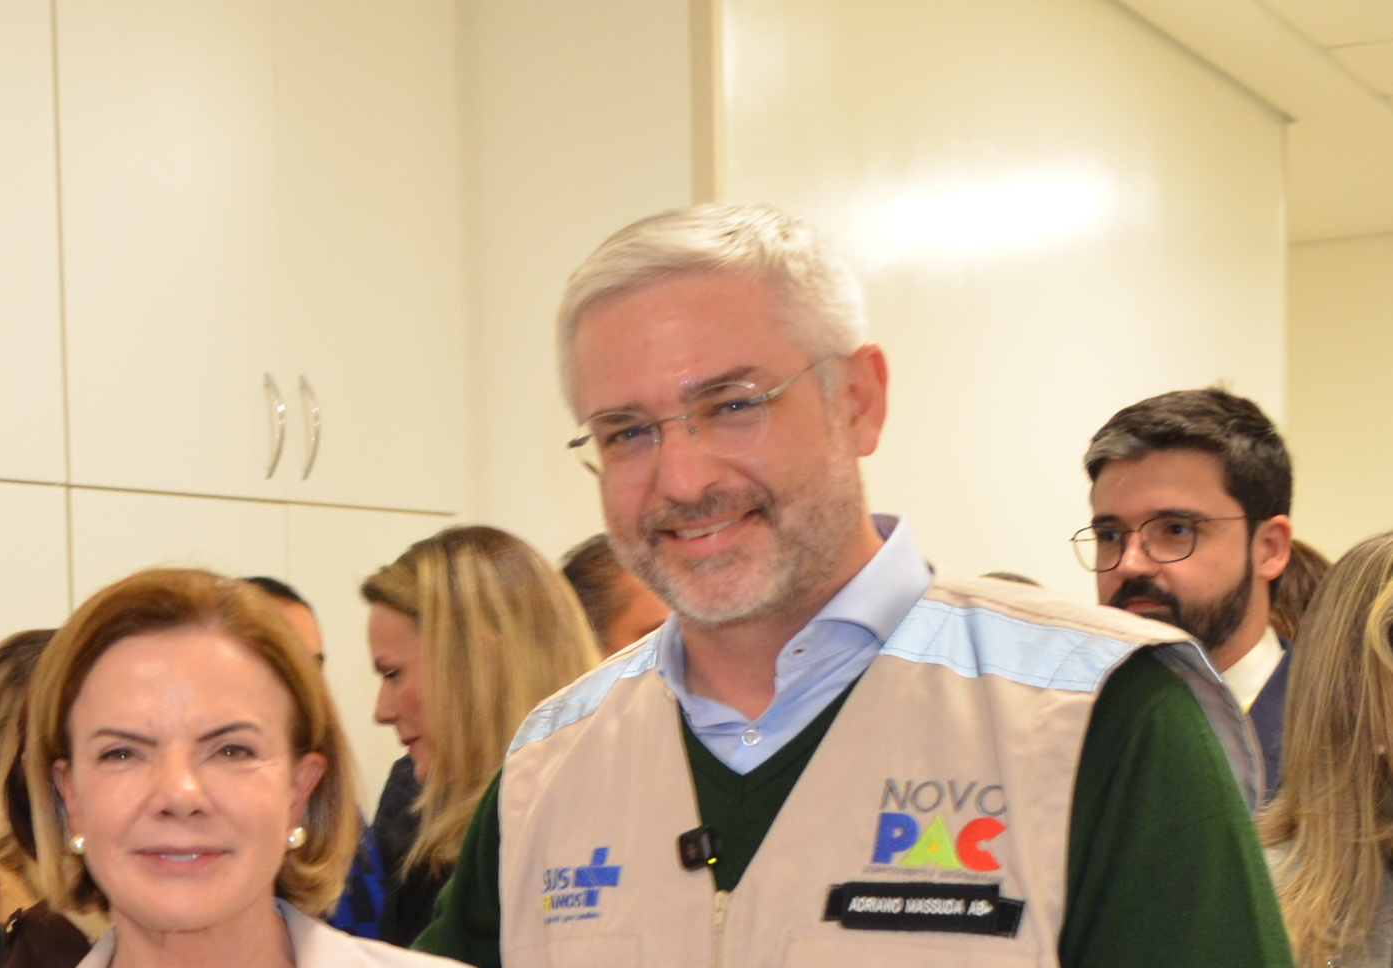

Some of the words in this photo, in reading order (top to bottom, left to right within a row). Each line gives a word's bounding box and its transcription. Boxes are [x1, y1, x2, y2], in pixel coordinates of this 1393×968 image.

[879, 778, 1007, 816] NOVO
[871, 811, 1007, 872] PAC
[847, 895, 905, 914] ADRIANO
[905, 897, 965, 916] MASSUDA
